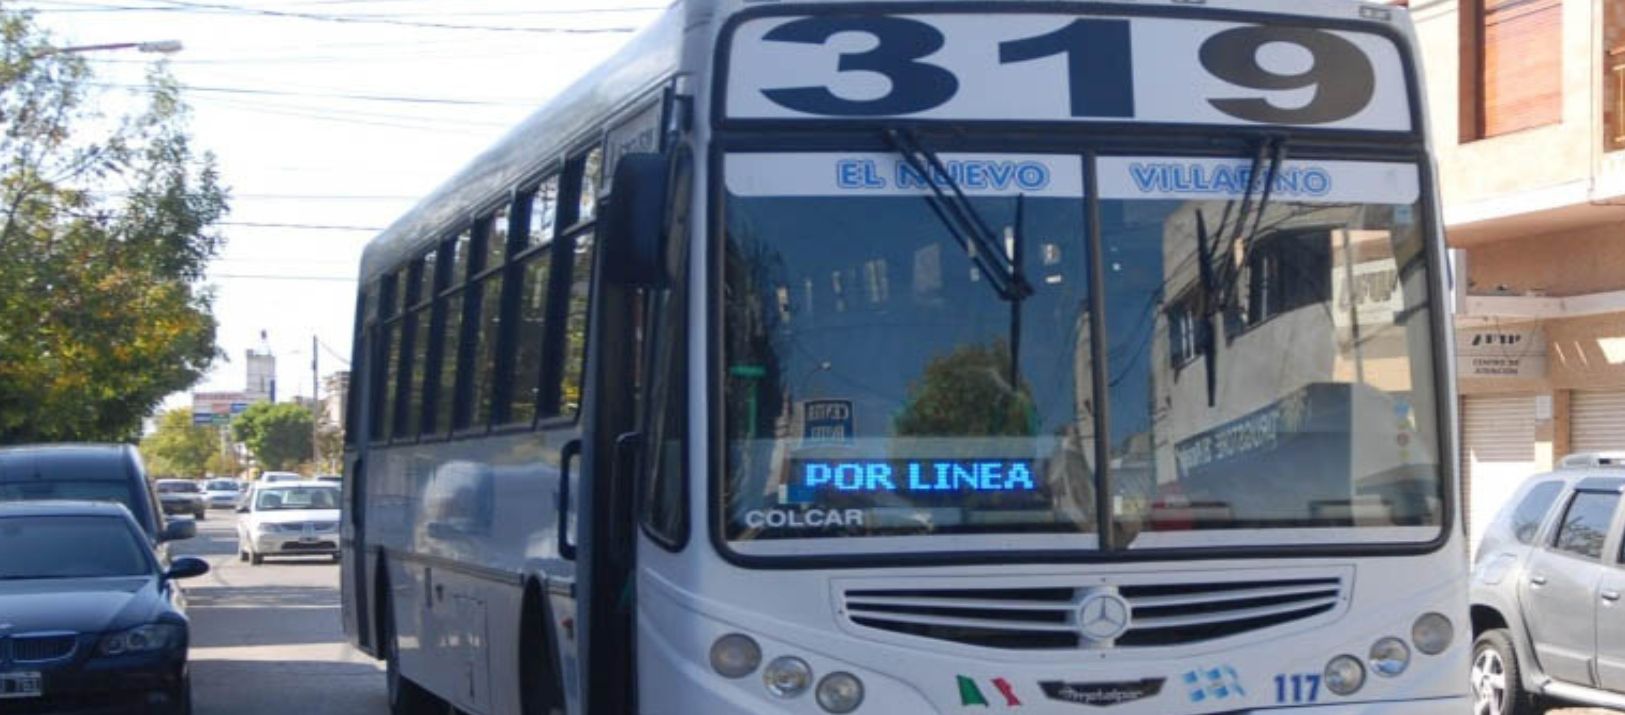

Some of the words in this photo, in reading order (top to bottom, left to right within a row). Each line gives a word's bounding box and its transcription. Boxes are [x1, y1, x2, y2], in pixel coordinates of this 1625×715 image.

[759, 15, 1375, 125] 319
[837, 159, 886, 189] EL
[895, 160, 1051, 191] NUEVO
[806, 462, 895, 490] POR
[909, 462, 1034, 490] LINEA
[744, 508, 864, 528] COLCAR
[1273, 674, 1321, 702] 117
